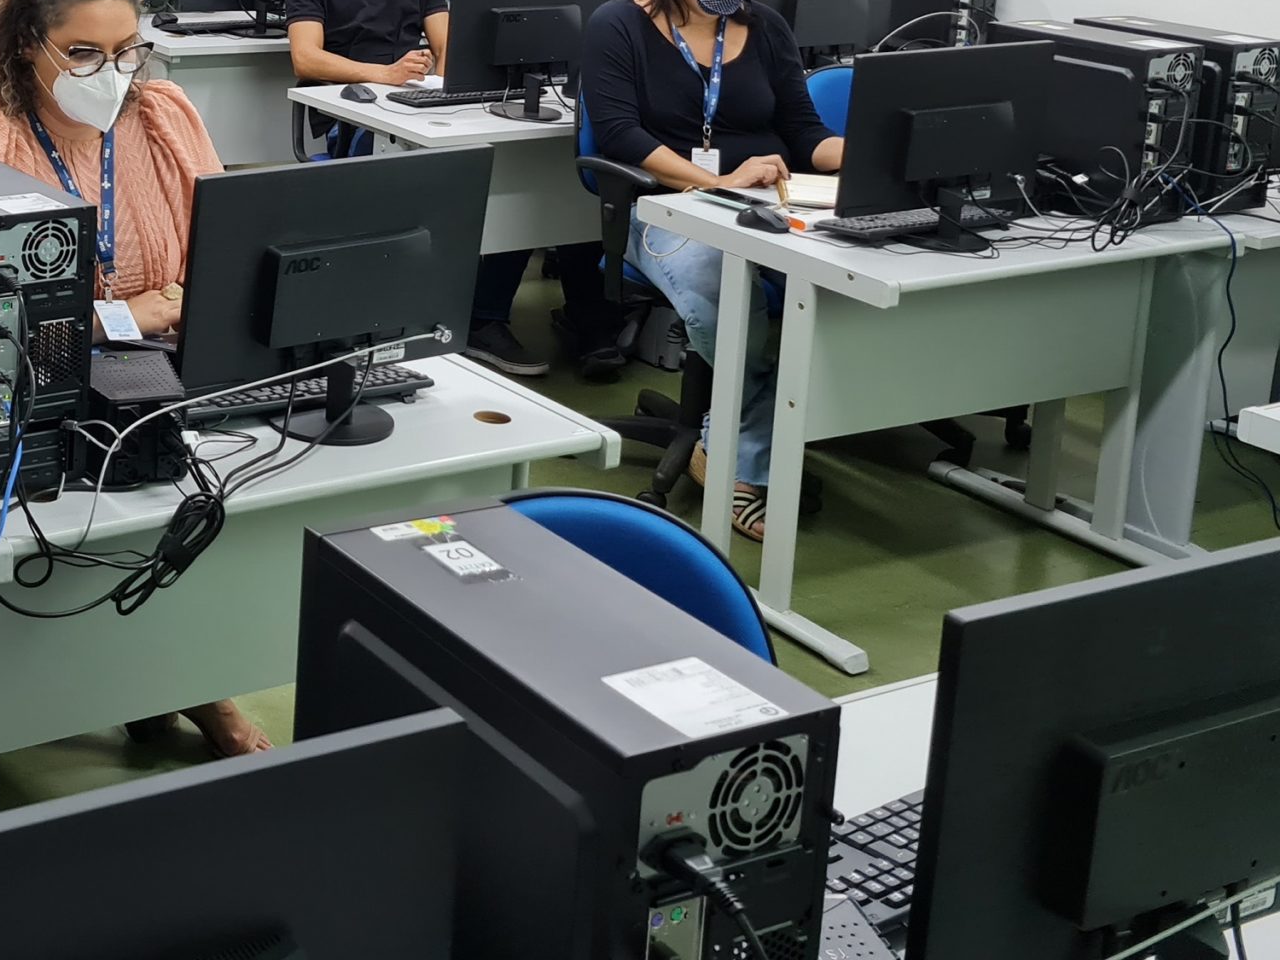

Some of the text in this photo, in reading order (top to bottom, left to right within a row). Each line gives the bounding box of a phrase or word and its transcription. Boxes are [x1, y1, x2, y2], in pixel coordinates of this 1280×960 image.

[284, 256, 322, 276] AOC
[437, 546, 474, 560] 02
[1111, 753, 1172, 793] AOC
